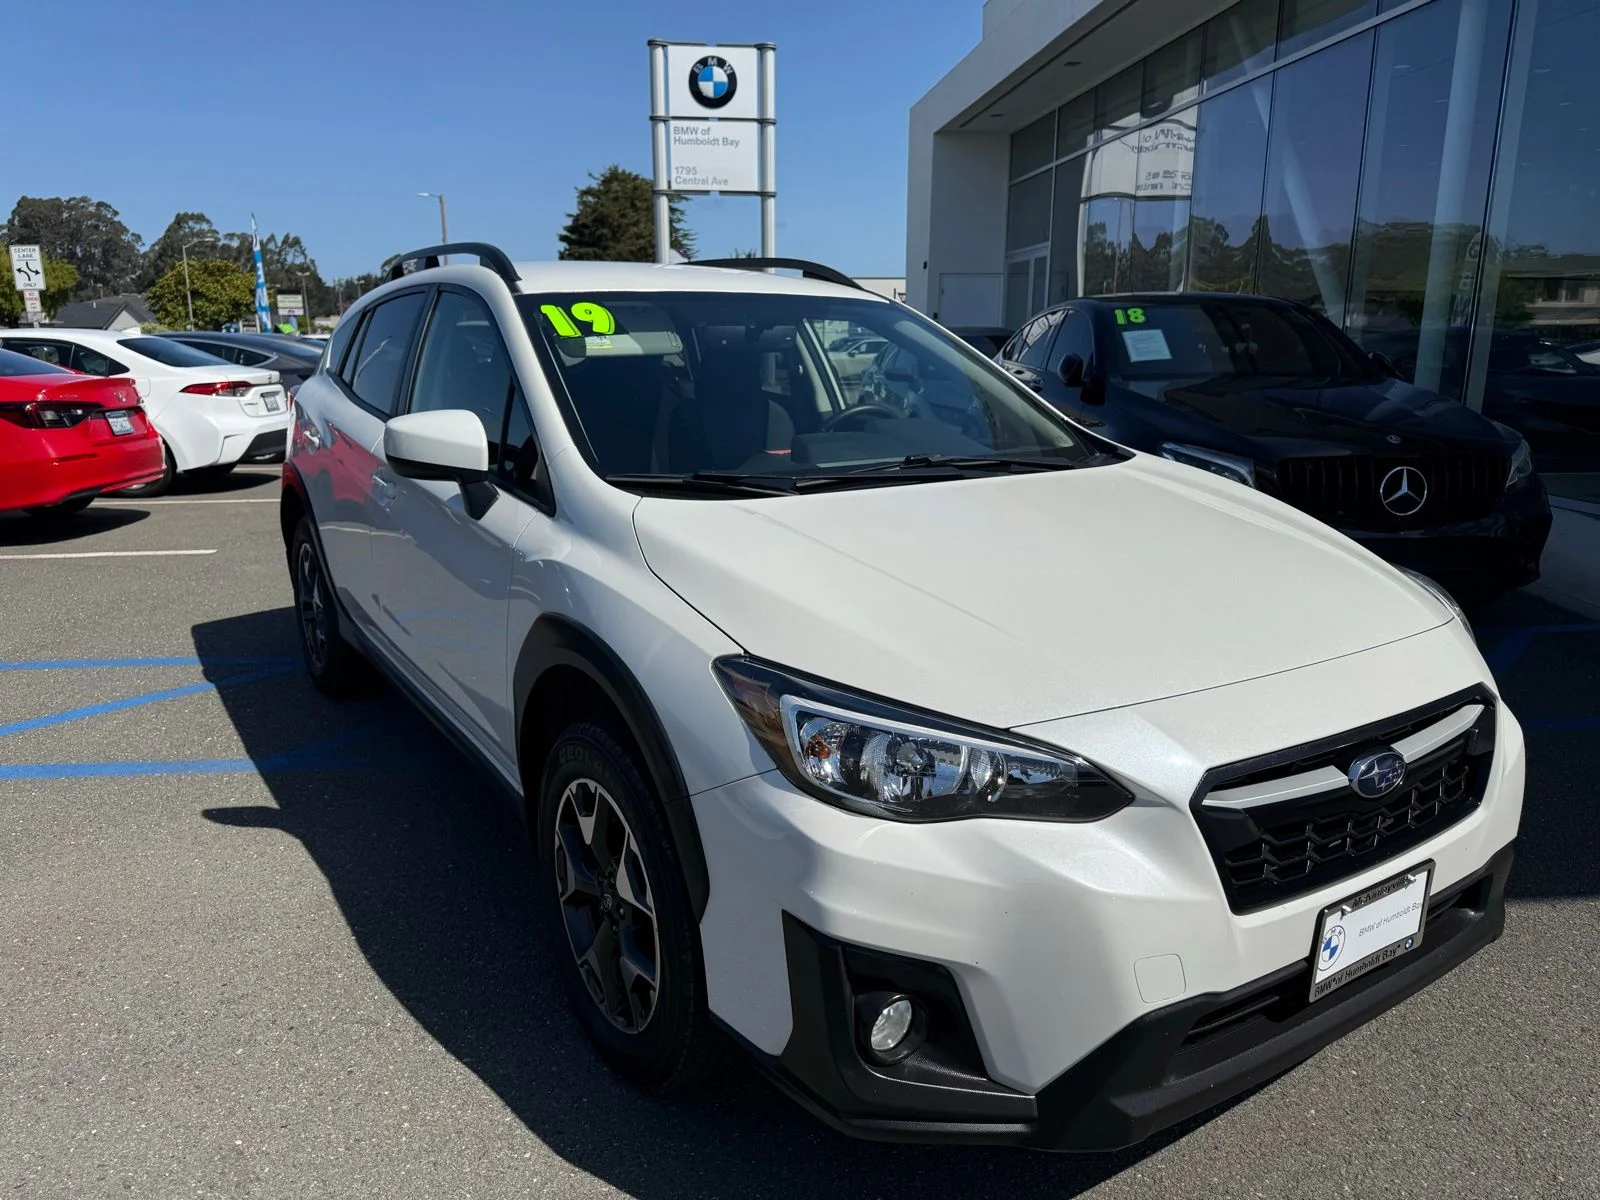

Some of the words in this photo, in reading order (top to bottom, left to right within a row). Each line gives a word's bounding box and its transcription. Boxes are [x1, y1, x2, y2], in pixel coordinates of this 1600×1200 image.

[693, 57, 733, 74] BMW
[673, 126, 699, 135] BMW
[700, 126, 711, 135] of
[673, 136, 720, 146] Humboldt
[722, 137, 740, 148] Bay
[675, 166, 697, 175] 1795
[675, 176, 709, 185] Central
[711, 177, 728, 186] Ave
[540, 302, 615, 337] 19
[1114, 307, 1147, 325] 18
[1359, 922, 1376, 937] BMW
[1376, 919, 1383, 929] of
[1383, 906, 1411, 925] Humboldt
[1335, 974, 1344, 988] of
[1344, 954, 1381, 979] Humboldt
